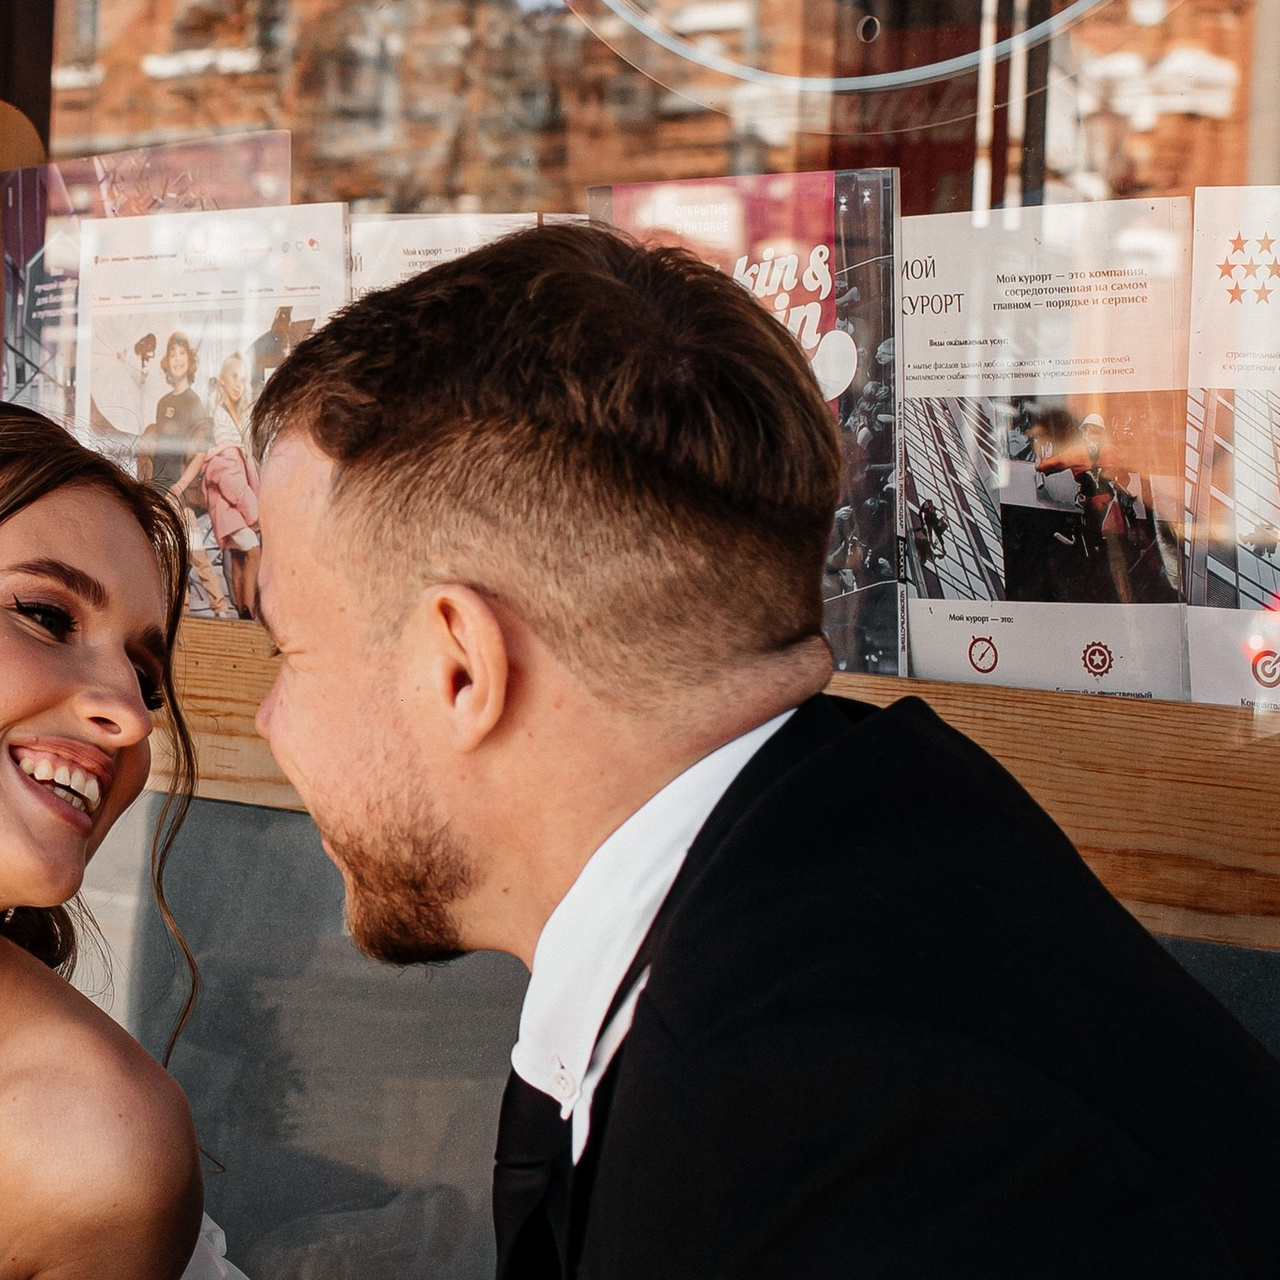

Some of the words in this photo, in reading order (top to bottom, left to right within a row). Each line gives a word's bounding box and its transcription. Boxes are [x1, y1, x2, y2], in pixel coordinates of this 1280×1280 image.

[996, 273, 1016, 284] Мой
[1018, 272, 1052, 285] курорт
[1068, 271, 1086, 280] это
[1089, 268, 1148, 280] компания,
[1004, 285, 1092, 298] сосредоточенная
[1095, 284, 1108, 292] на
[1111, 281, 1148, 292] самом
[993, 301, 1032, 311] главном
[1045, 297, 1089, 310] порядке
[1092, 297, 1099, 306] и
[1102, 294, 1148, 308] сервисе
[933, 360, 959, 371] фасадов
[1055, 357, 1100, 367] подготовка
[1102, 355, 1131, 364] отелей
[981, 371, 1040, 381] государственных
[1042, 368, 1090, 380] учреждений
[1100, 366, 1135, 376] бизнеса
[948, 613, 965, 622] Мой
[965, 615, 989, 625] курорт
[1000, 616, 1014, 624] это:
